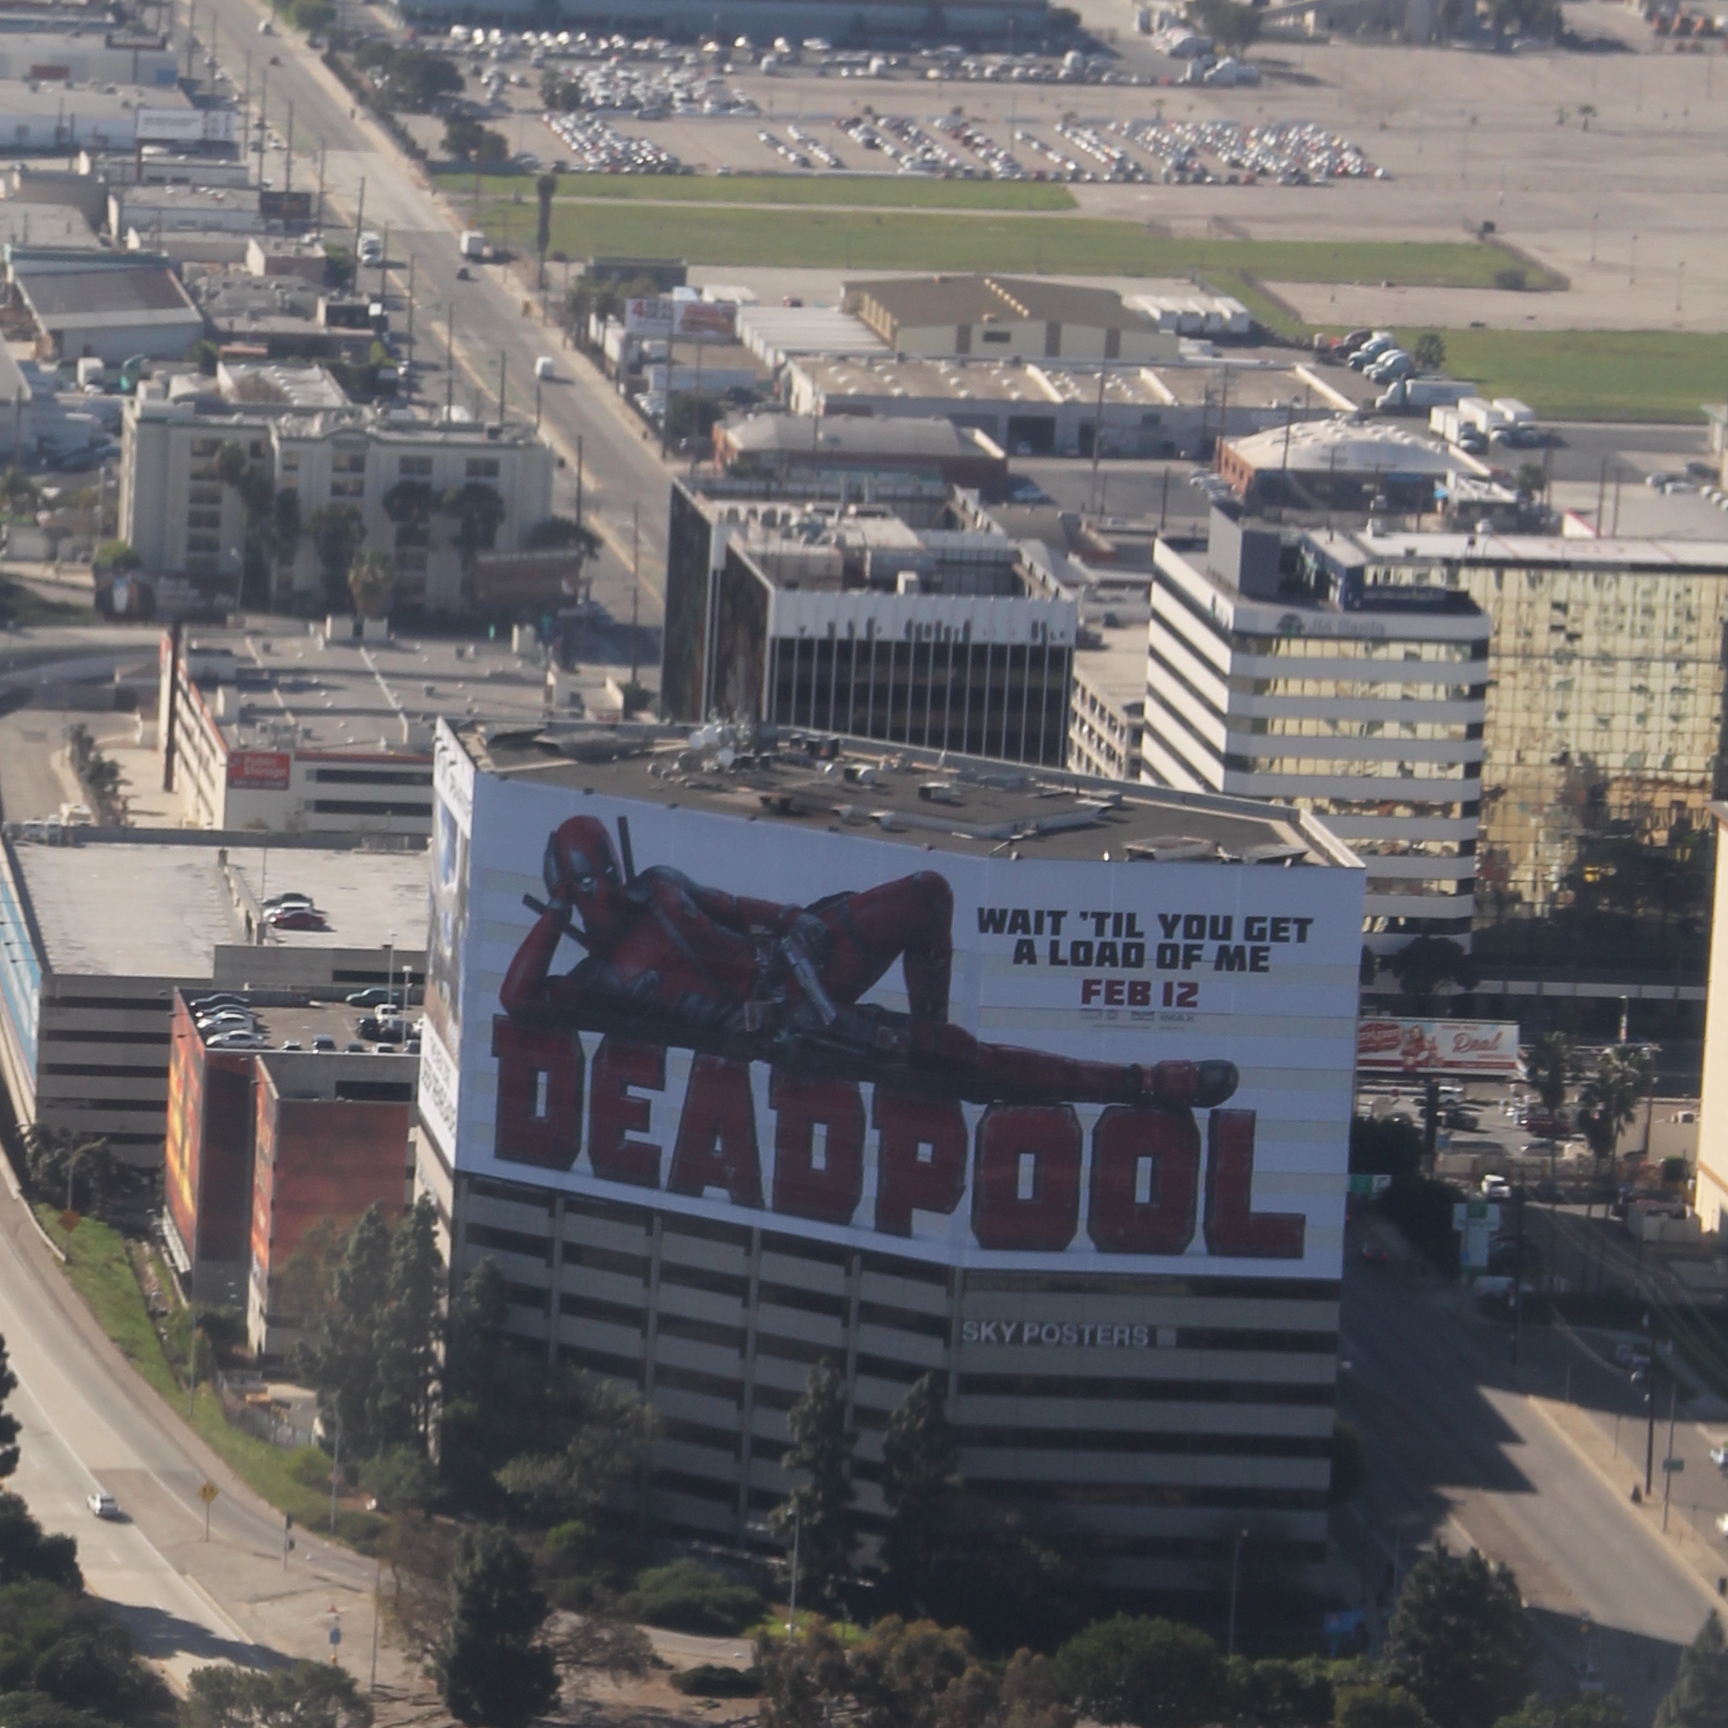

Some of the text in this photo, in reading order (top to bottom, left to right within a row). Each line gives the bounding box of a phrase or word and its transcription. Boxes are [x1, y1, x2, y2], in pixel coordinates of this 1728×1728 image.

[244, 767, 287, 779] Storage
[977, 907, 1314, 944] WAIT 'TIL YOU GET
[1013, 939, 1271, 973] A LOAD OF ME
[1081, 978, 1199, 1008] FEB 12
[492, 1013, 1306, 1259] DEADPOOL
[962, 1321, 1149, 1347] SKY POSTERS
